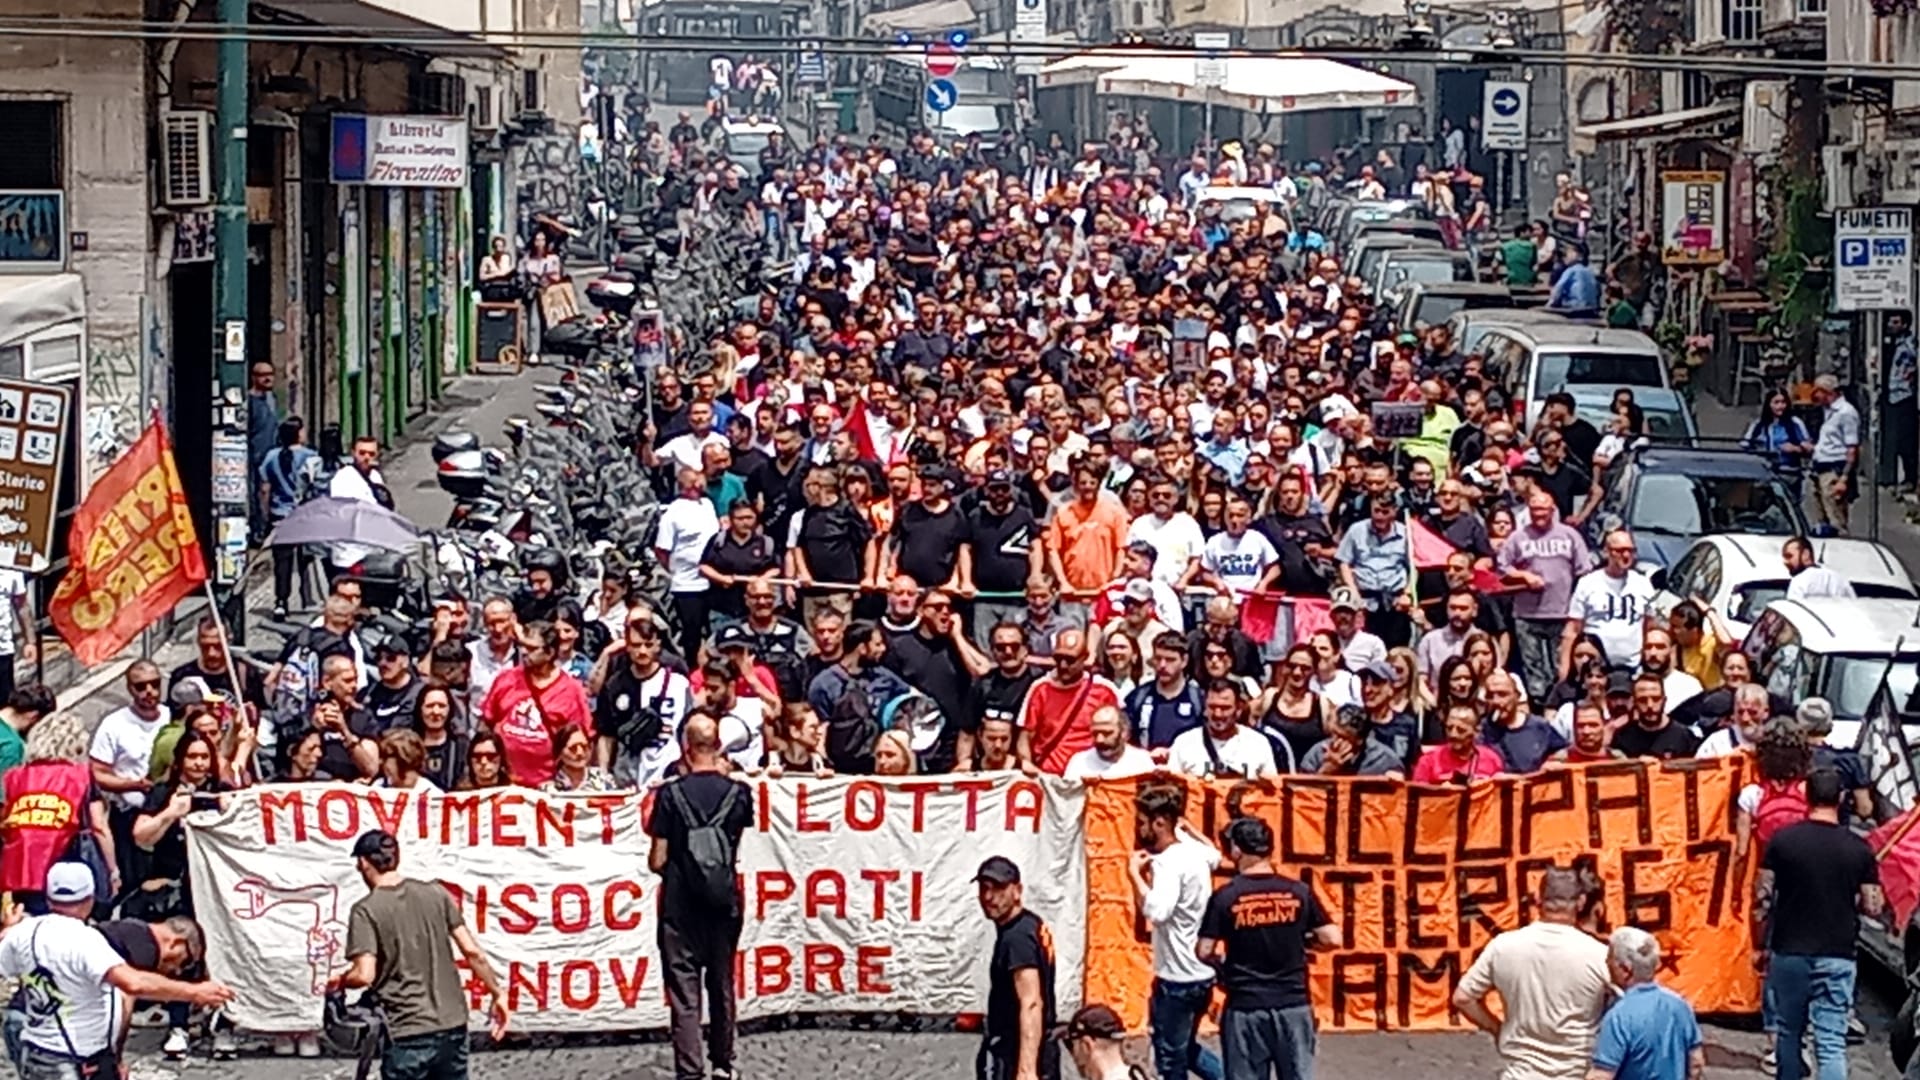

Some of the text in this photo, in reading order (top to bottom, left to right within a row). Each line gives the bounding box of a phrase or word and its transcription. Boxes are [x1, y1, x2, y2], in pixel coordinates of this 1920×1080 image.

[368, 160, 462, 182] Fiorentino
[1839, 210, 1909, 229] FUMETTI
[1846, 242, 1864, 264] P
[258, 789, 656, 846] MOVIMENT
[797, 779, 1044, 834] LOTTA
